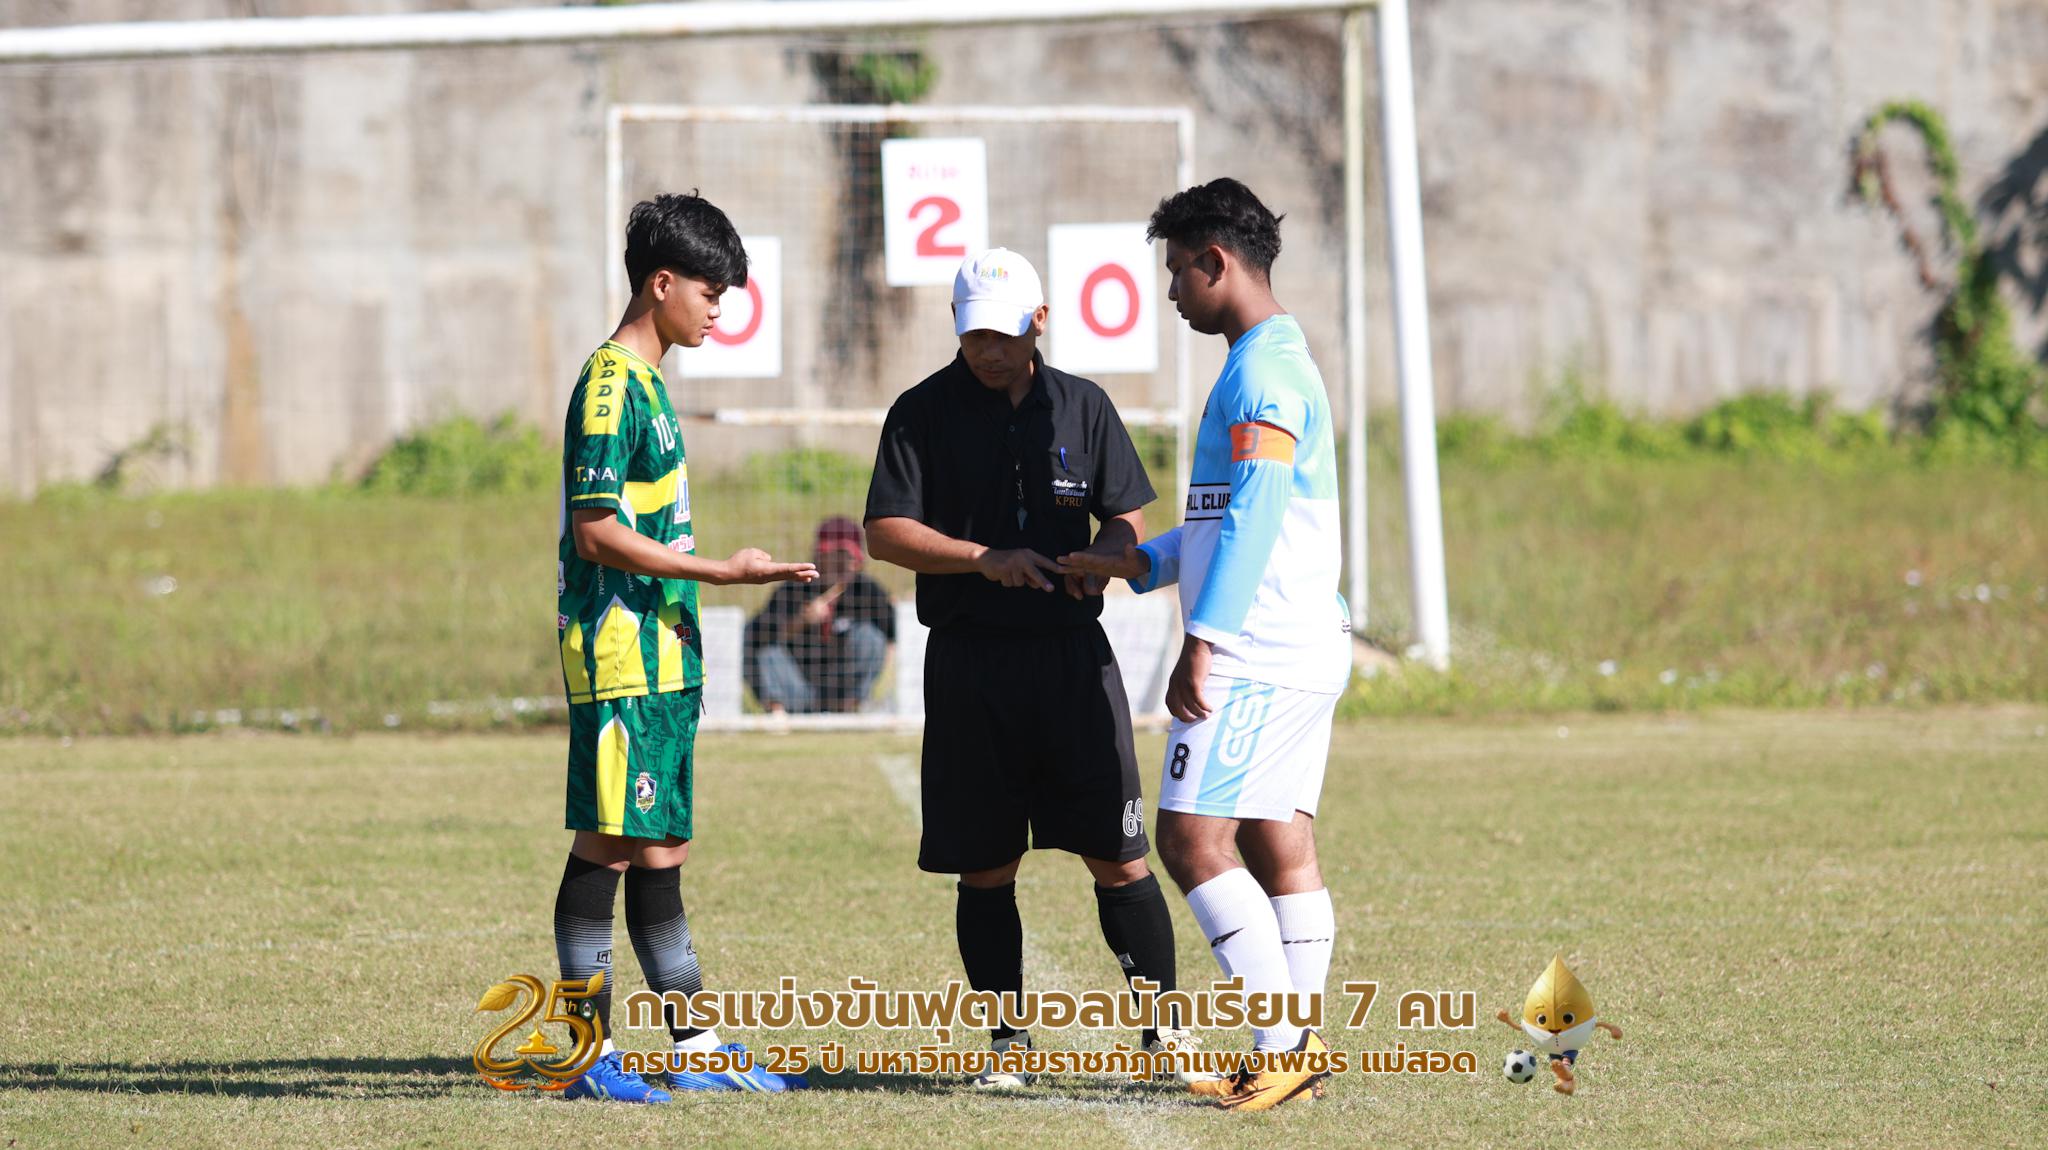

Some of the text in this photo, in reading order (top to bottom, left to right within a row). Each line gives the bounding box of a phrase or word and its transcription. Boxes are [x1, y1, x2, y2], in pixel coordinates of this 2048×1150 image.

[908, 195, 967, 257] 2
[1079, 262, 1140, 338] 0
[652, 413, 676, 455] 10
[1169, 742, 1191, 782] 8
[1122, 797, 1143, 837] 69
